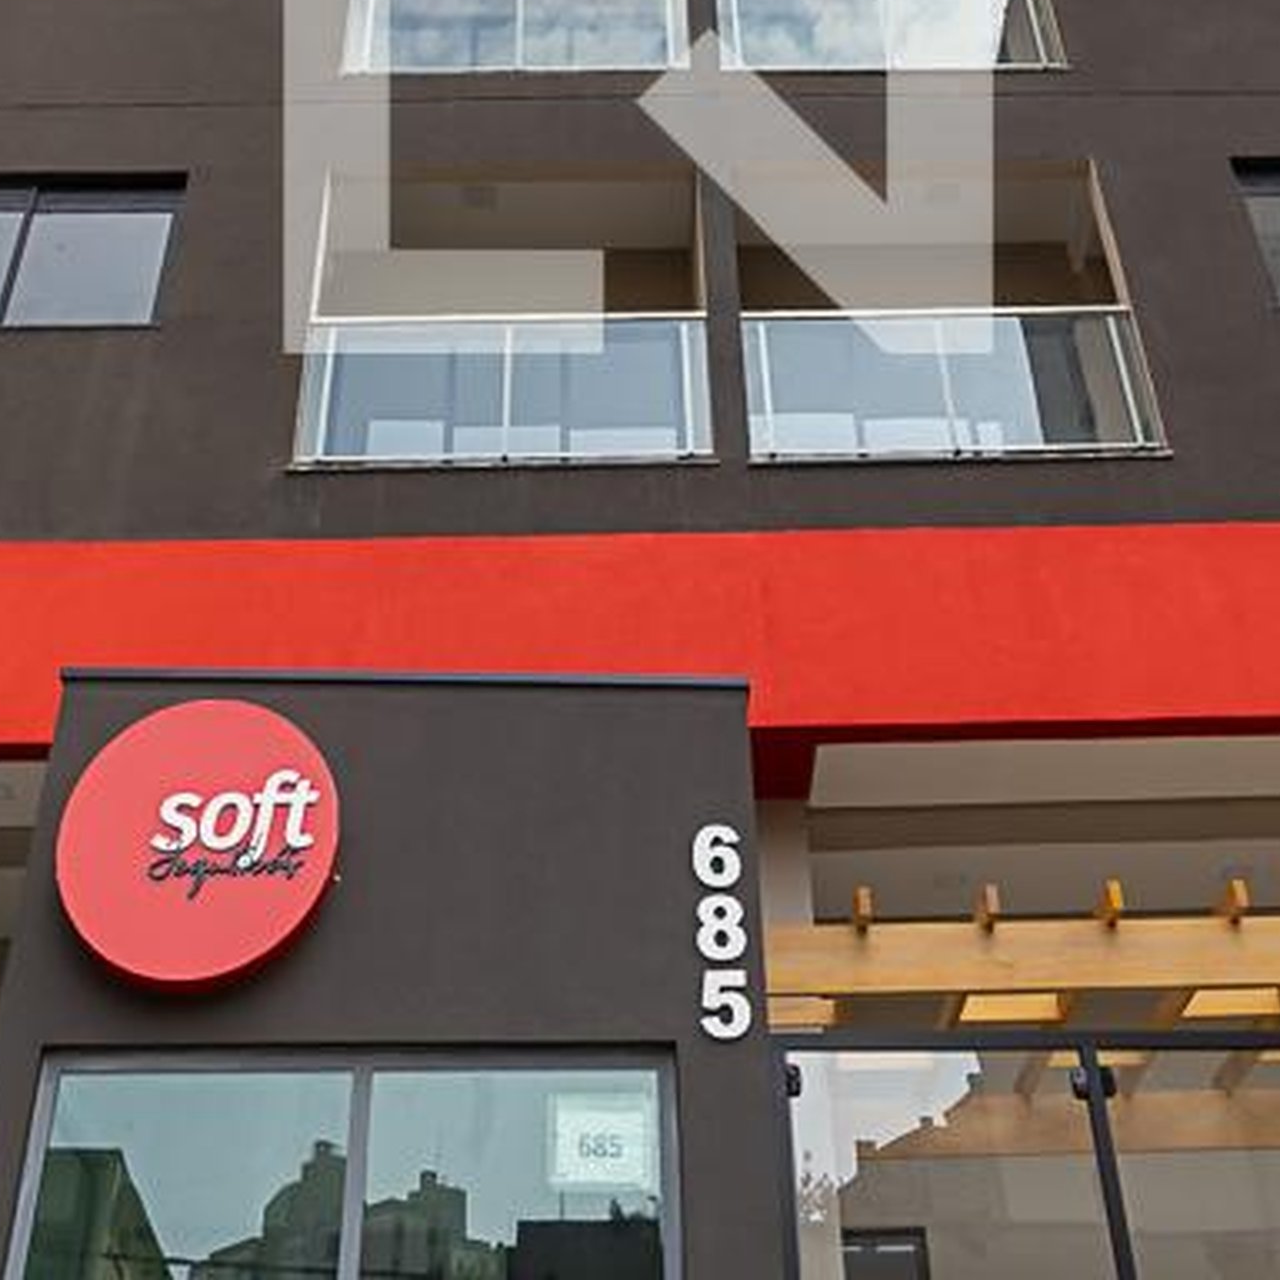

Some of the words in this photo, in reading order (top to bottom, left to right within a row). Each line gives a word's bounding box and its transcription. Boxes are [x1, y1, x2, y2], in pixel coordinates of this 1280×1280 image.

[149, 769, 320, 869] soft
[692, 824, 752, 1039] 685
[579, 1133, 623, 1159] 685
